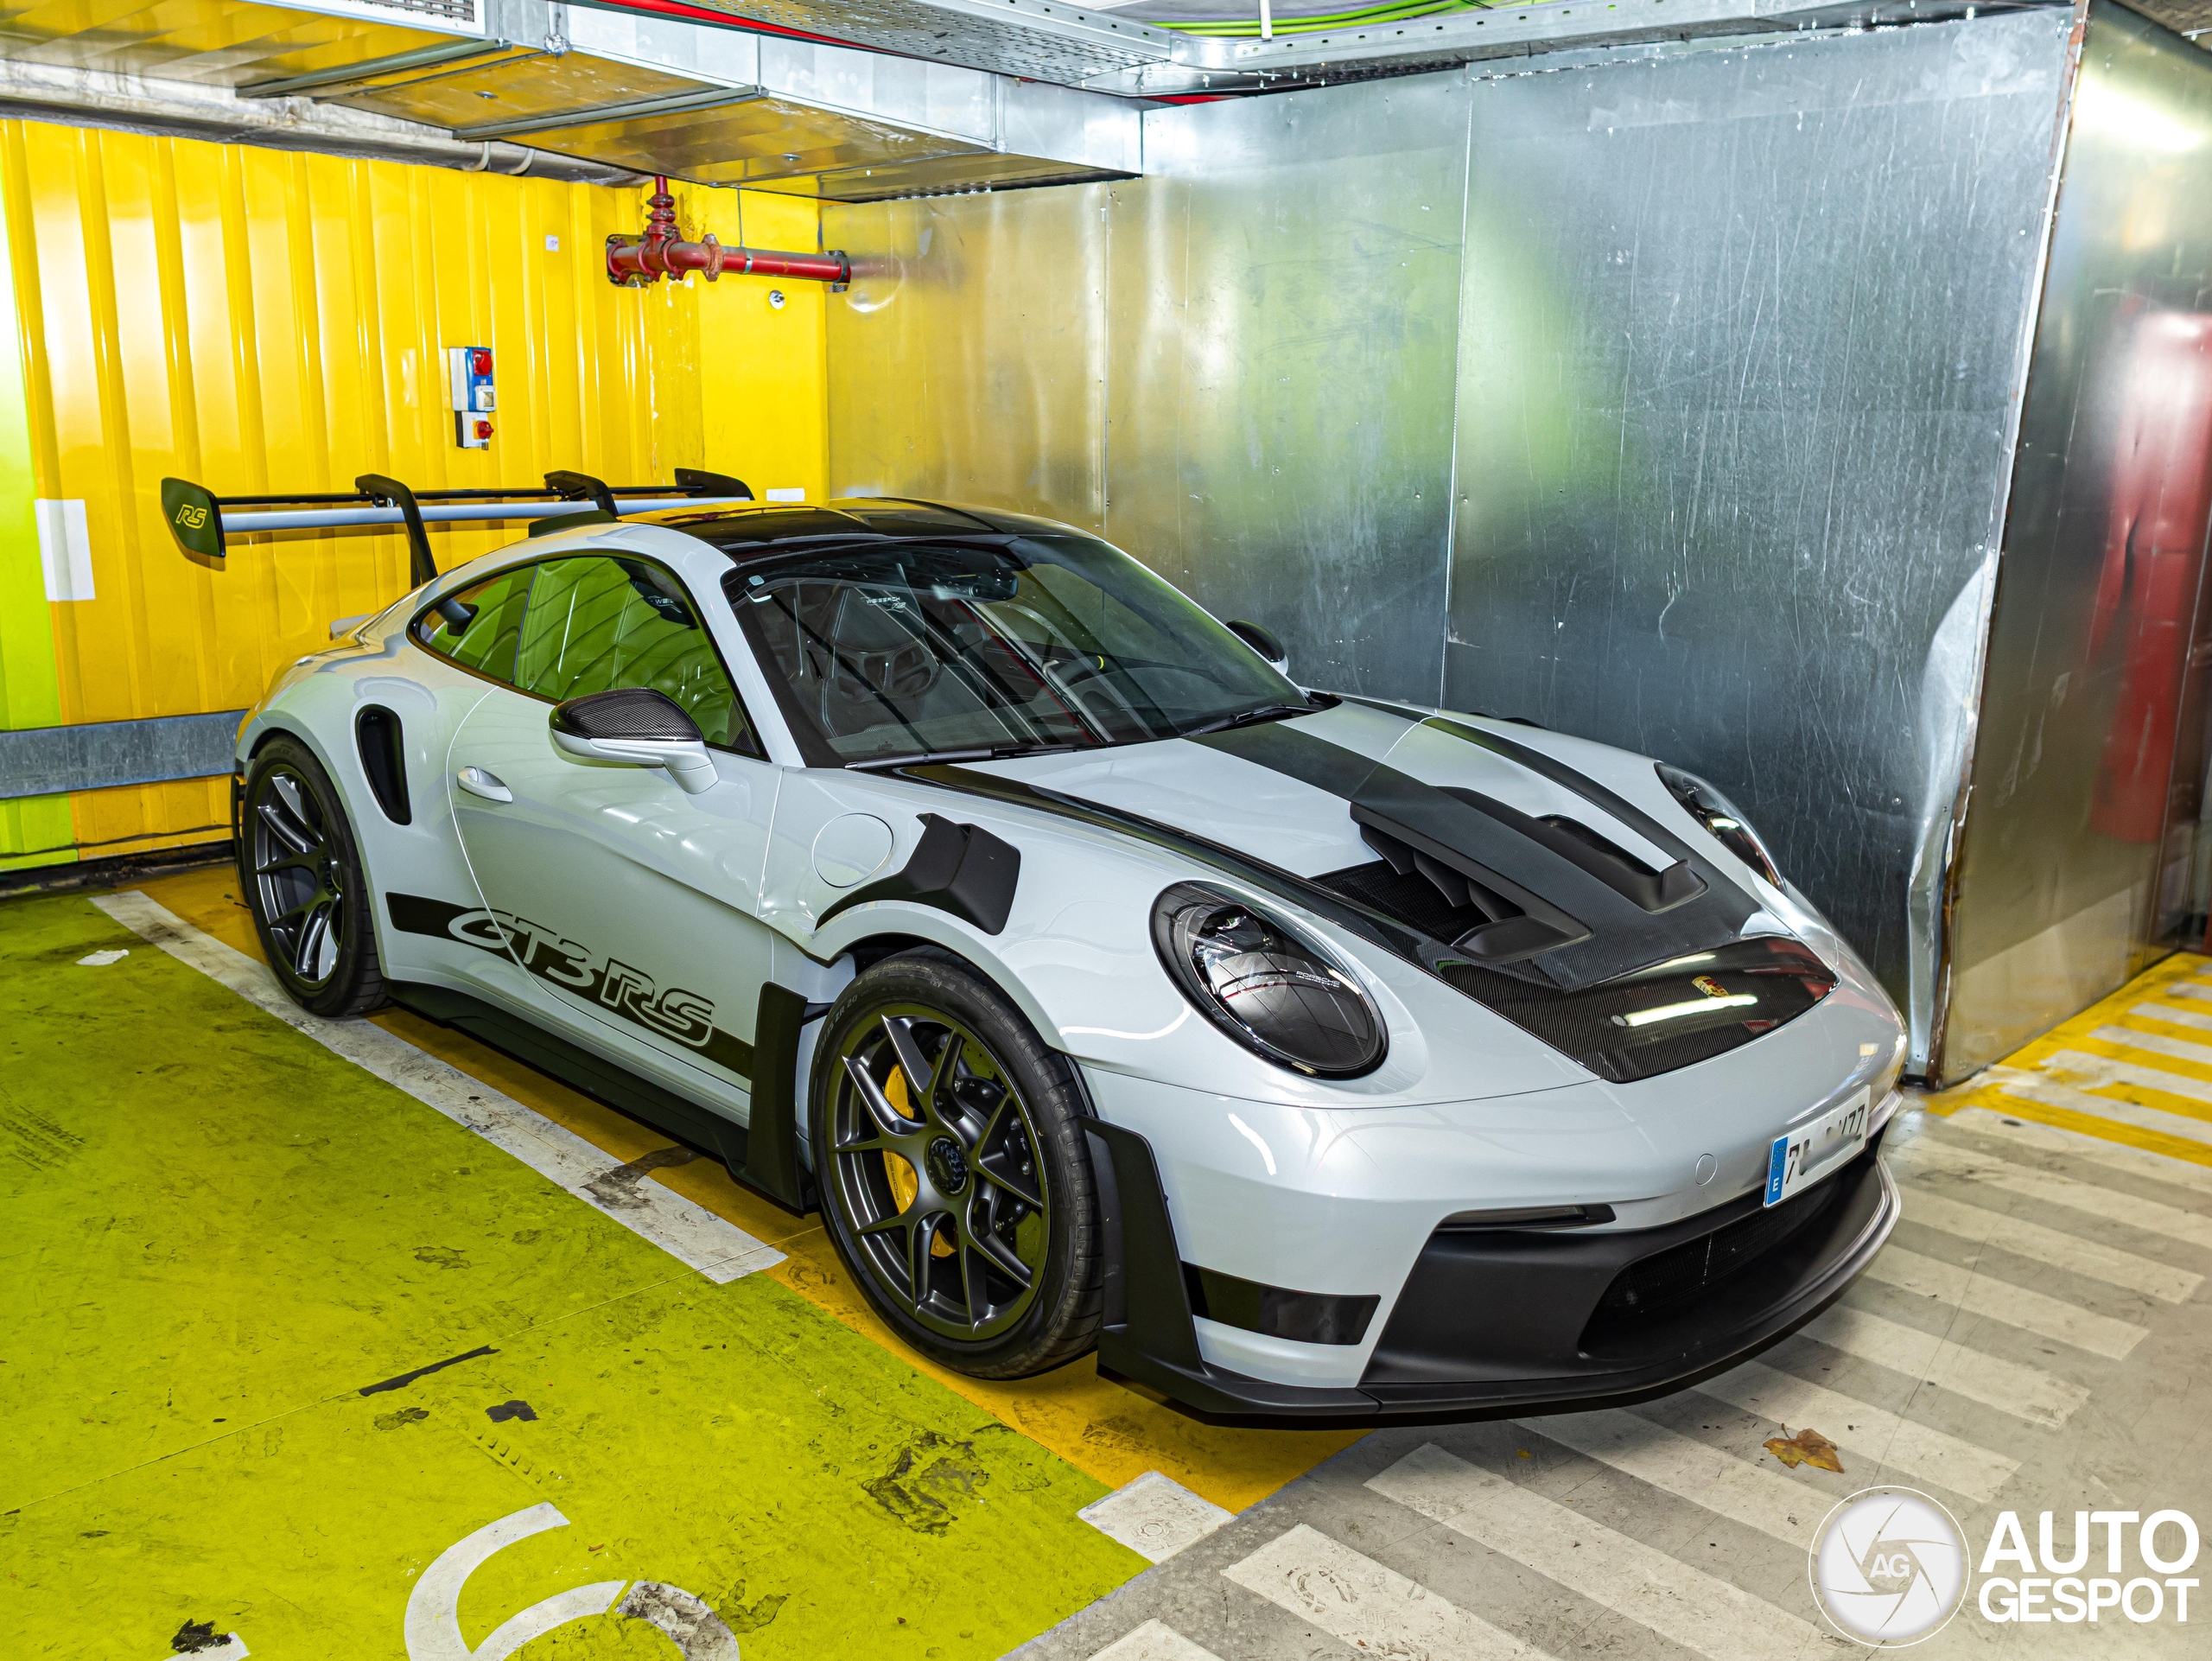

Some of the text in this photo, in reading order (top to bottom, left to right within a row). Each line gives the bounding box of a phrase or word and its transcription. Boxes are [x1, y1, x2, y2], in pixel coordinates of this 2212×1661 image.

[175, 504, 207, 530] RS
[1296, 971, 1340, 986] PORSCHE
[1772, 1178, 1780, 1193] E
